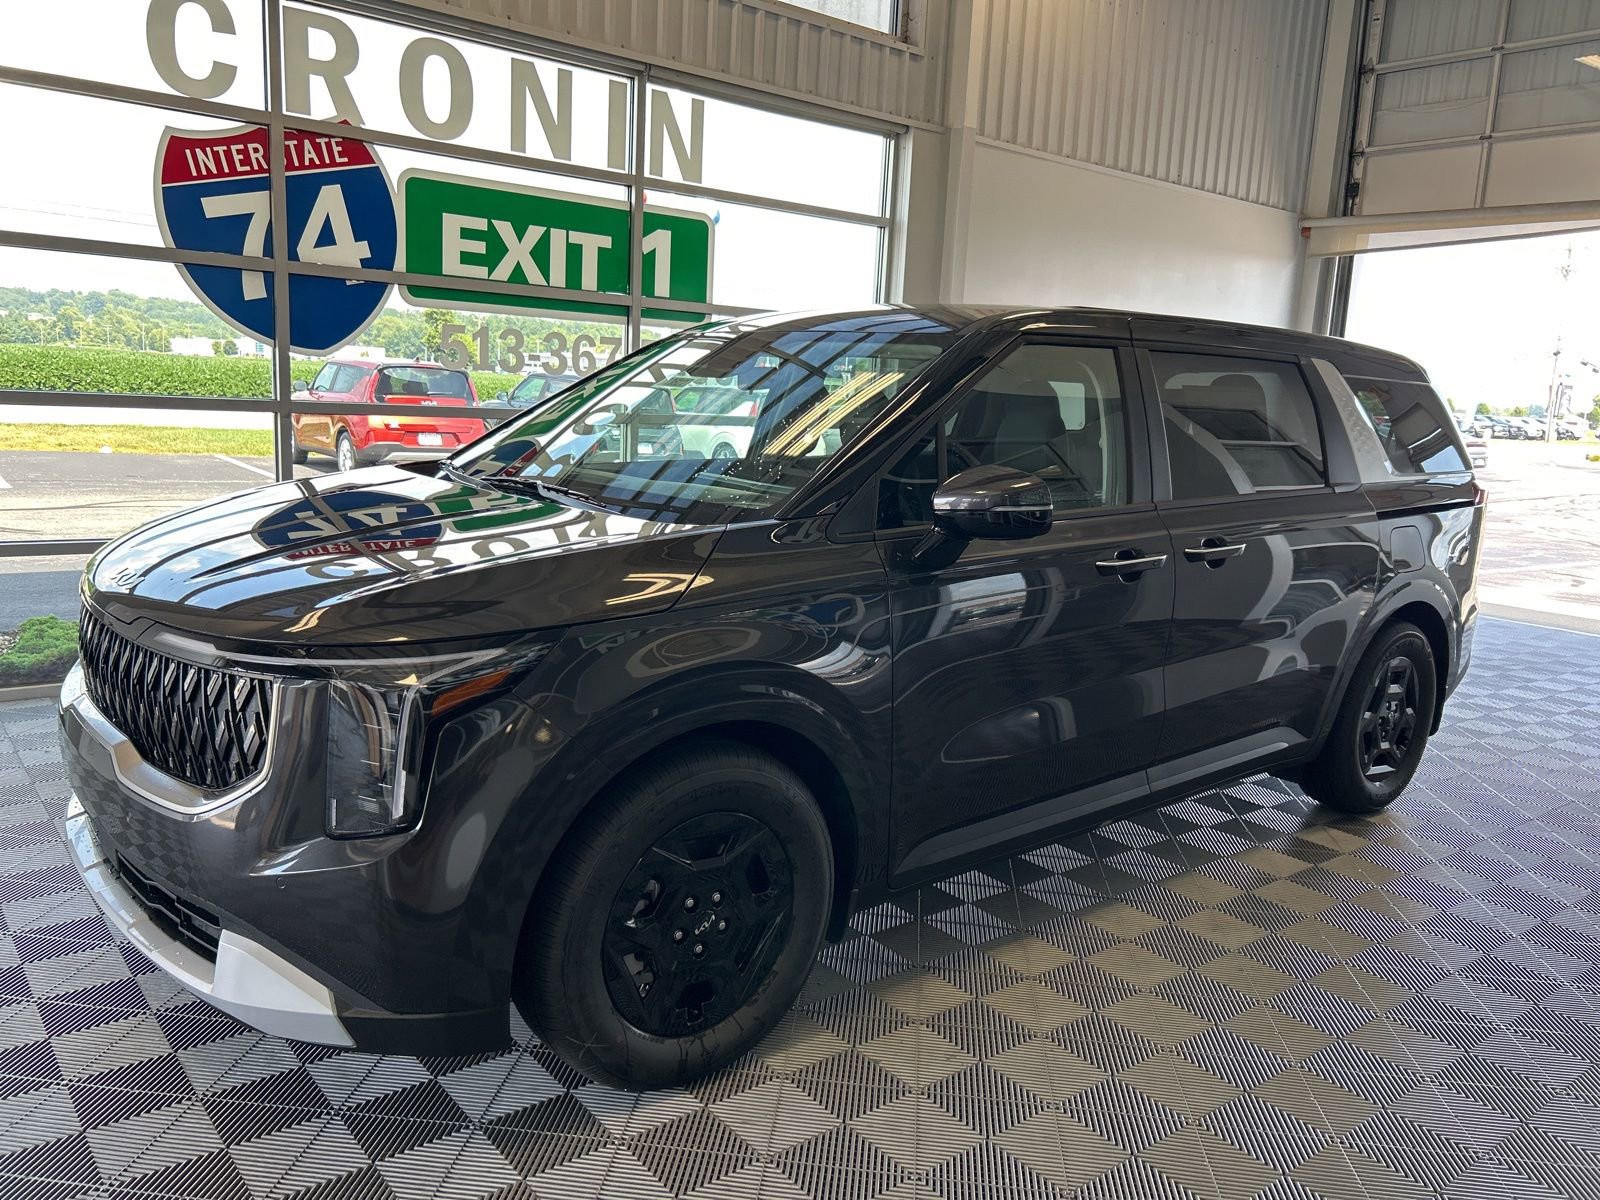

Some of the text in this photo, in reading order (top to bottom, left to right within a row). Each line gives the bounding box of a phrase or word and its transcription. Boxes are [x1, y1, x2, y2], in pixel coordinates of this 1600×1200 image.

[146, 0, 705, 184] CRONIN
[185, 137, 349, 177] INTERTATE
[200, 184, 371, 300] 74
[442, 212, 672, 298] EXIT 1
